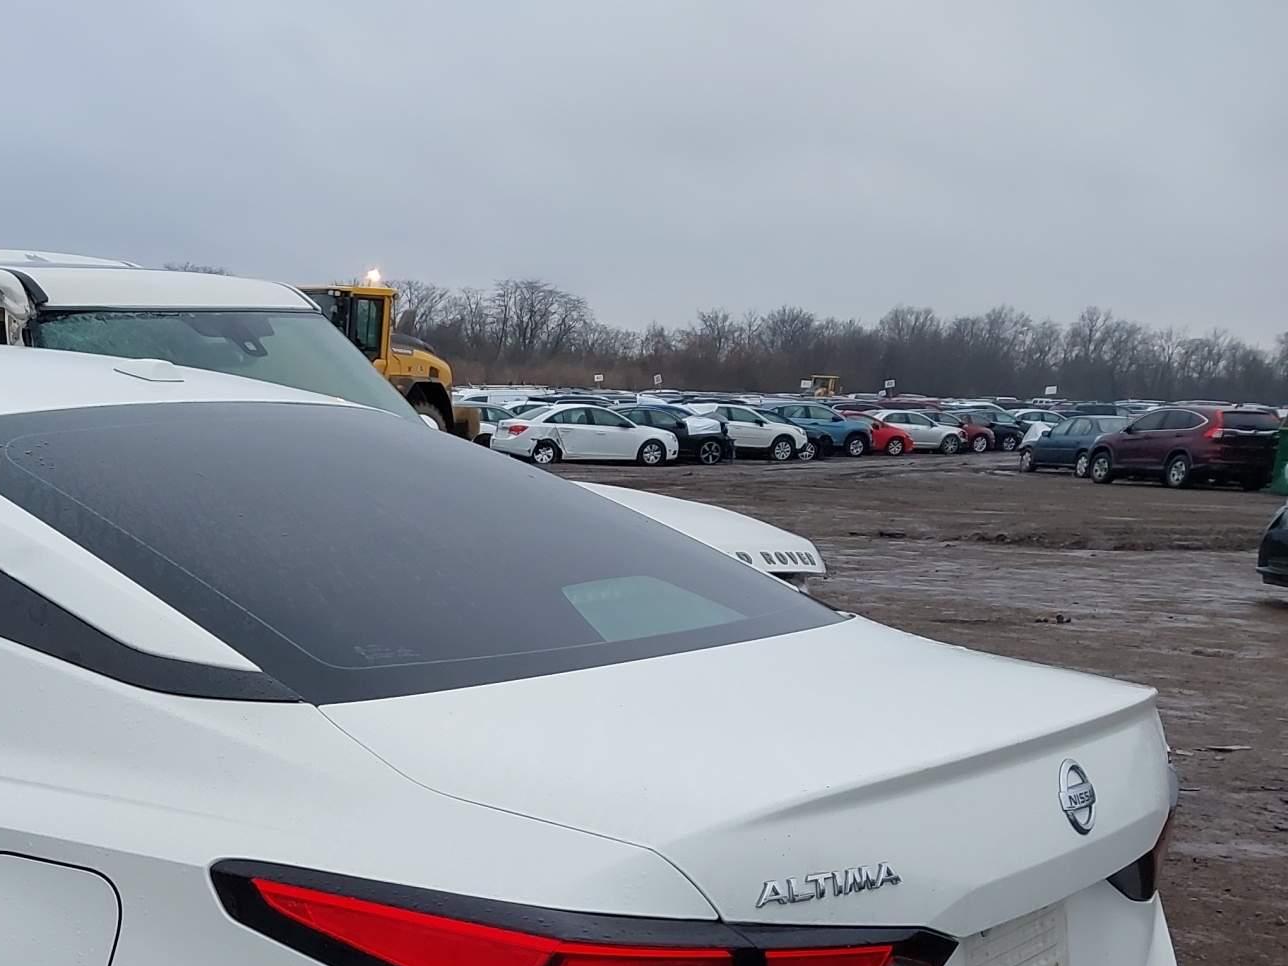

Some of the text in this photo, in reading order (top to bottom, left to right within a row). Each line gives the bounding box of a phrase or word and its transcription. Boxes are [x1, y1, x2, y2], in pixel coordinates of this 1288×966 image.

[760, 552, 816, 565] ROVER
[1068, 789, 1093, 807] NISS
[755, 861, 902, 908] ALTIMA
